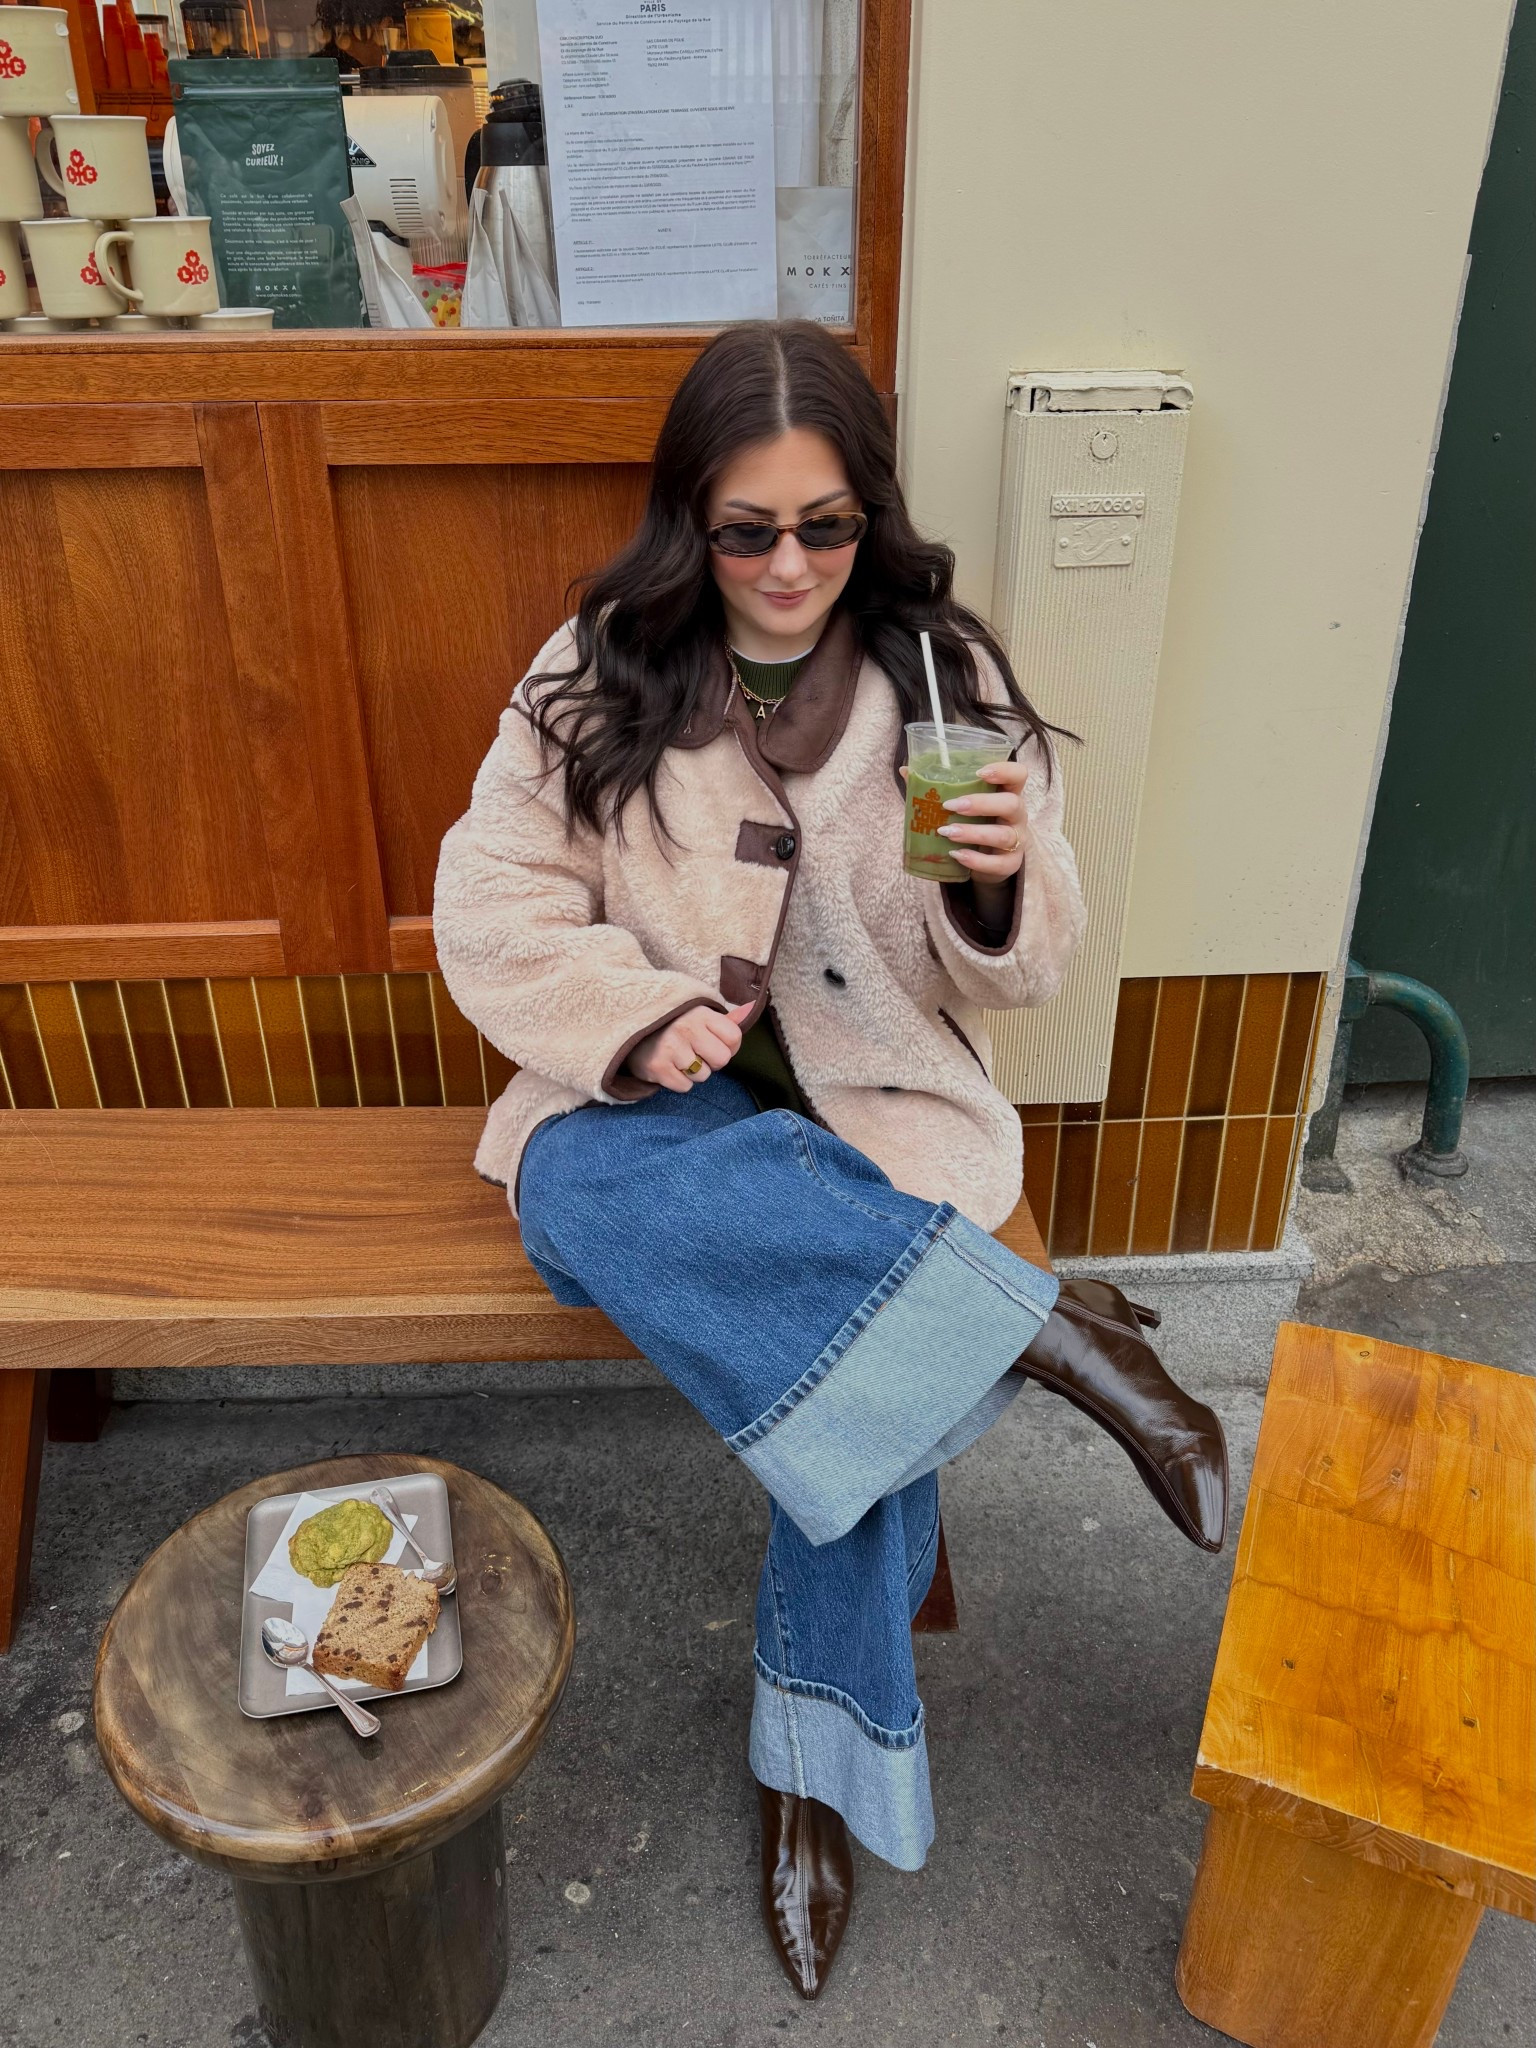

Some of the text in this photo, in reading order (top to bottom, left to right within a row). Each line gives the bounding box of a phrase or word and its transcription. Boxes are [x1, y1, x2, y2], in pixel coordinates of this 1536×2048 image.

[640, 4, 666, 12] PARIS
[252, 144, 274, 155] SOYEZ
[246, 154, 283, 166] CURIEUX !
[350, 156, 370, 165] ÖNIG
